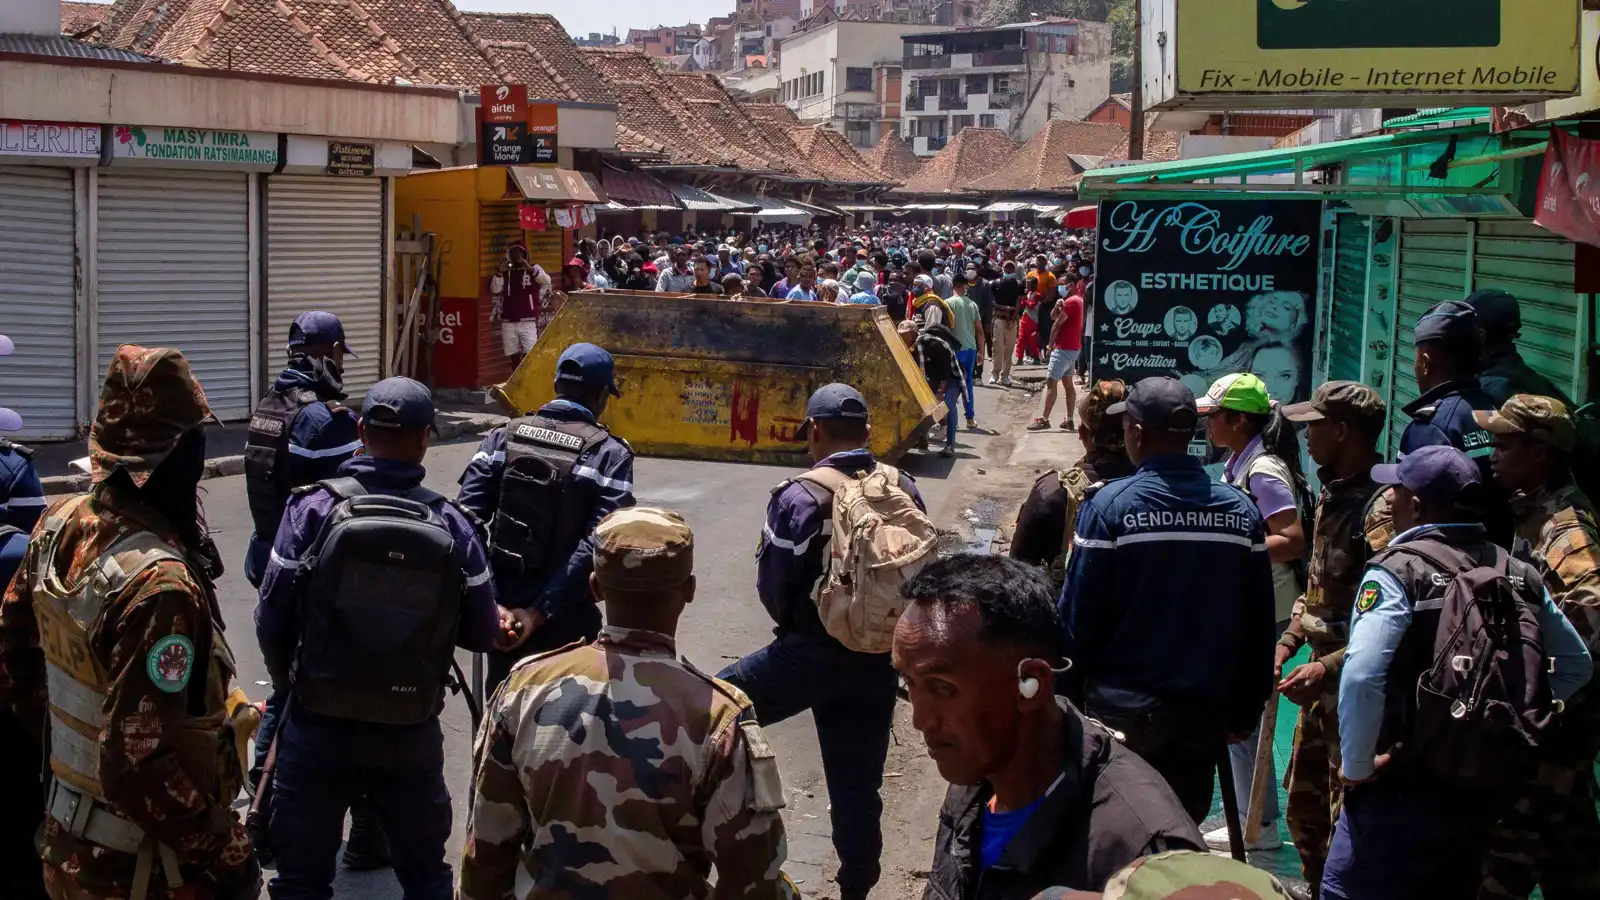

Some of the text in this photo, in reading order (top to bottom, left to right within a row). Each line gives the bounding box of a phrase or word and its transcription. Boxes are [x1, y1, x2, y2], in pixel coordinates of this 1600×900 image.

[1200, 69, 1234, 88] Fix
[1258, 68, 1343, 87] Mobile
[1367, 67, 1466, 86] Internet
[1472, 65, 1557, 85] Mobile
[491, 104, 516, 113] airtel
[163, 128, 250, 147] MASY IMRA
[145, 143, 277, 163] FONDATION RATSIMAMANGA
[493, 144, 521, 153] Orange
[494, 153, 520, 161] Money
[1141, 272, 1275, 291] ESTHETIQUE
[1114, 317, 1162, 338] Coupe
[1112, 352, 1176, 371] Coloration
[517, 424, 583, 449] GENDARMERIE
[1123, 511, 1250, 531] GENDARMERIE
